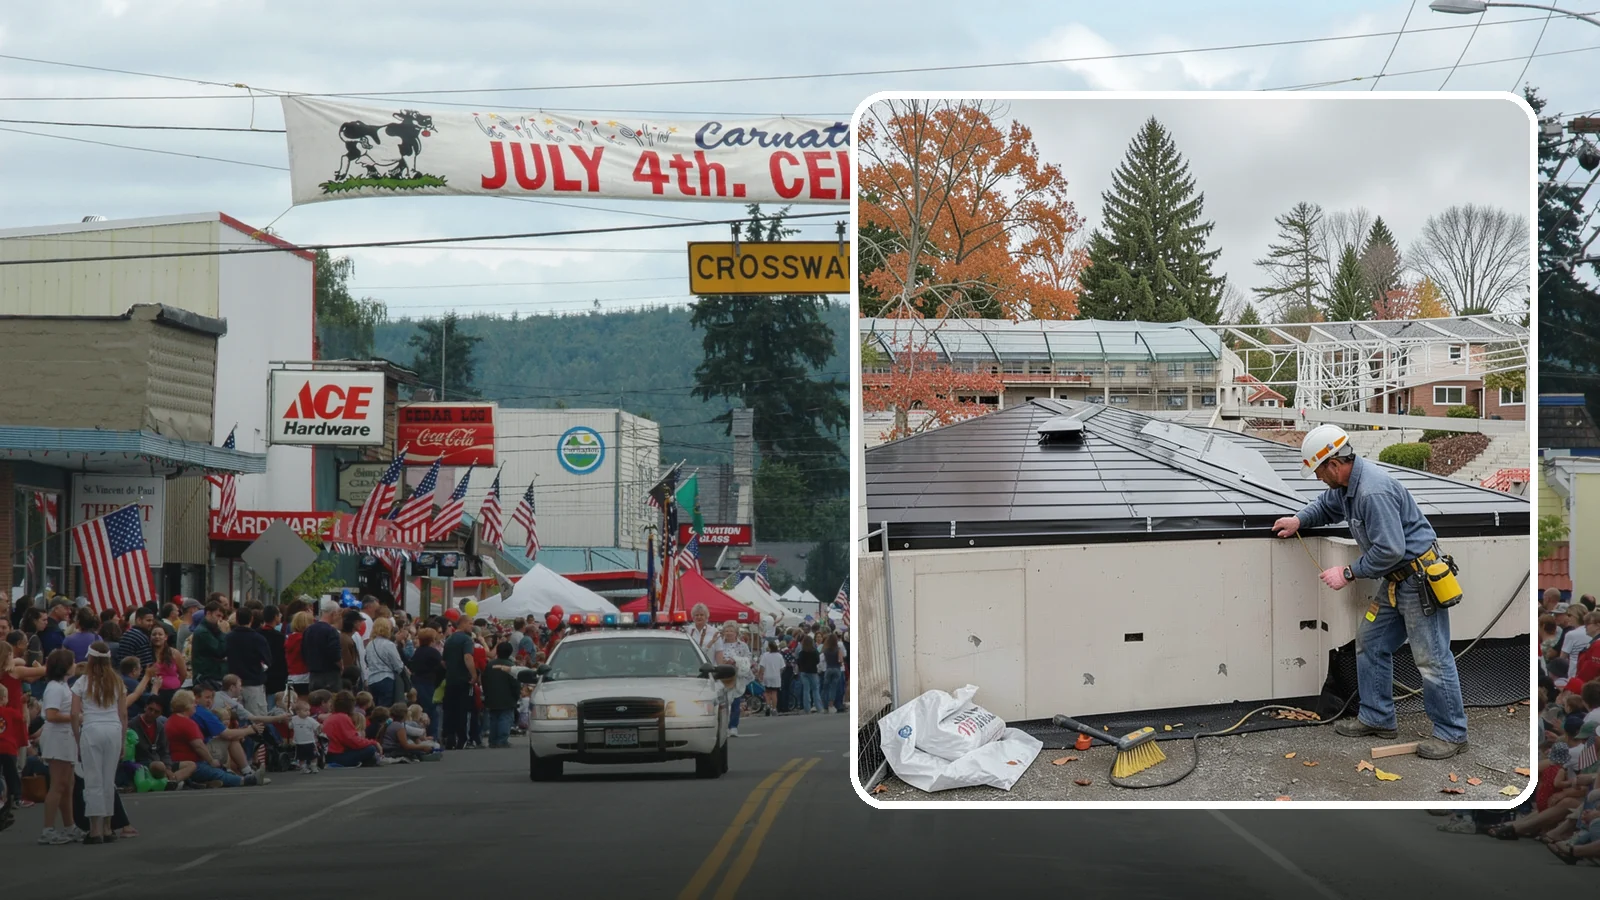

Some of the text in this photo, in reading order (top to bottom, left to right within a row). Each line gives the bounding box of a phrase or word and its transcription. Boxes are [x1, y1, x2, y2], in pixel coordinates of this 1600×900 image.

[481, 141, 604, 193] JULY
[632, 150, 746, 198] 4th.
[697, 254, 850, 280] CROSSWA
[282, 380, 373, 420] ACE
[405, 409, 452, 422] CEDAR
[283, 421, 370, 437] Hardware
[416, 428, 477, 447] Coca-Cola
[83, 484, 155, 495] St. Vincent de Paul
[688, 526, 742, 535] CRNATION
[699, 535, 730, 543] GLASS
